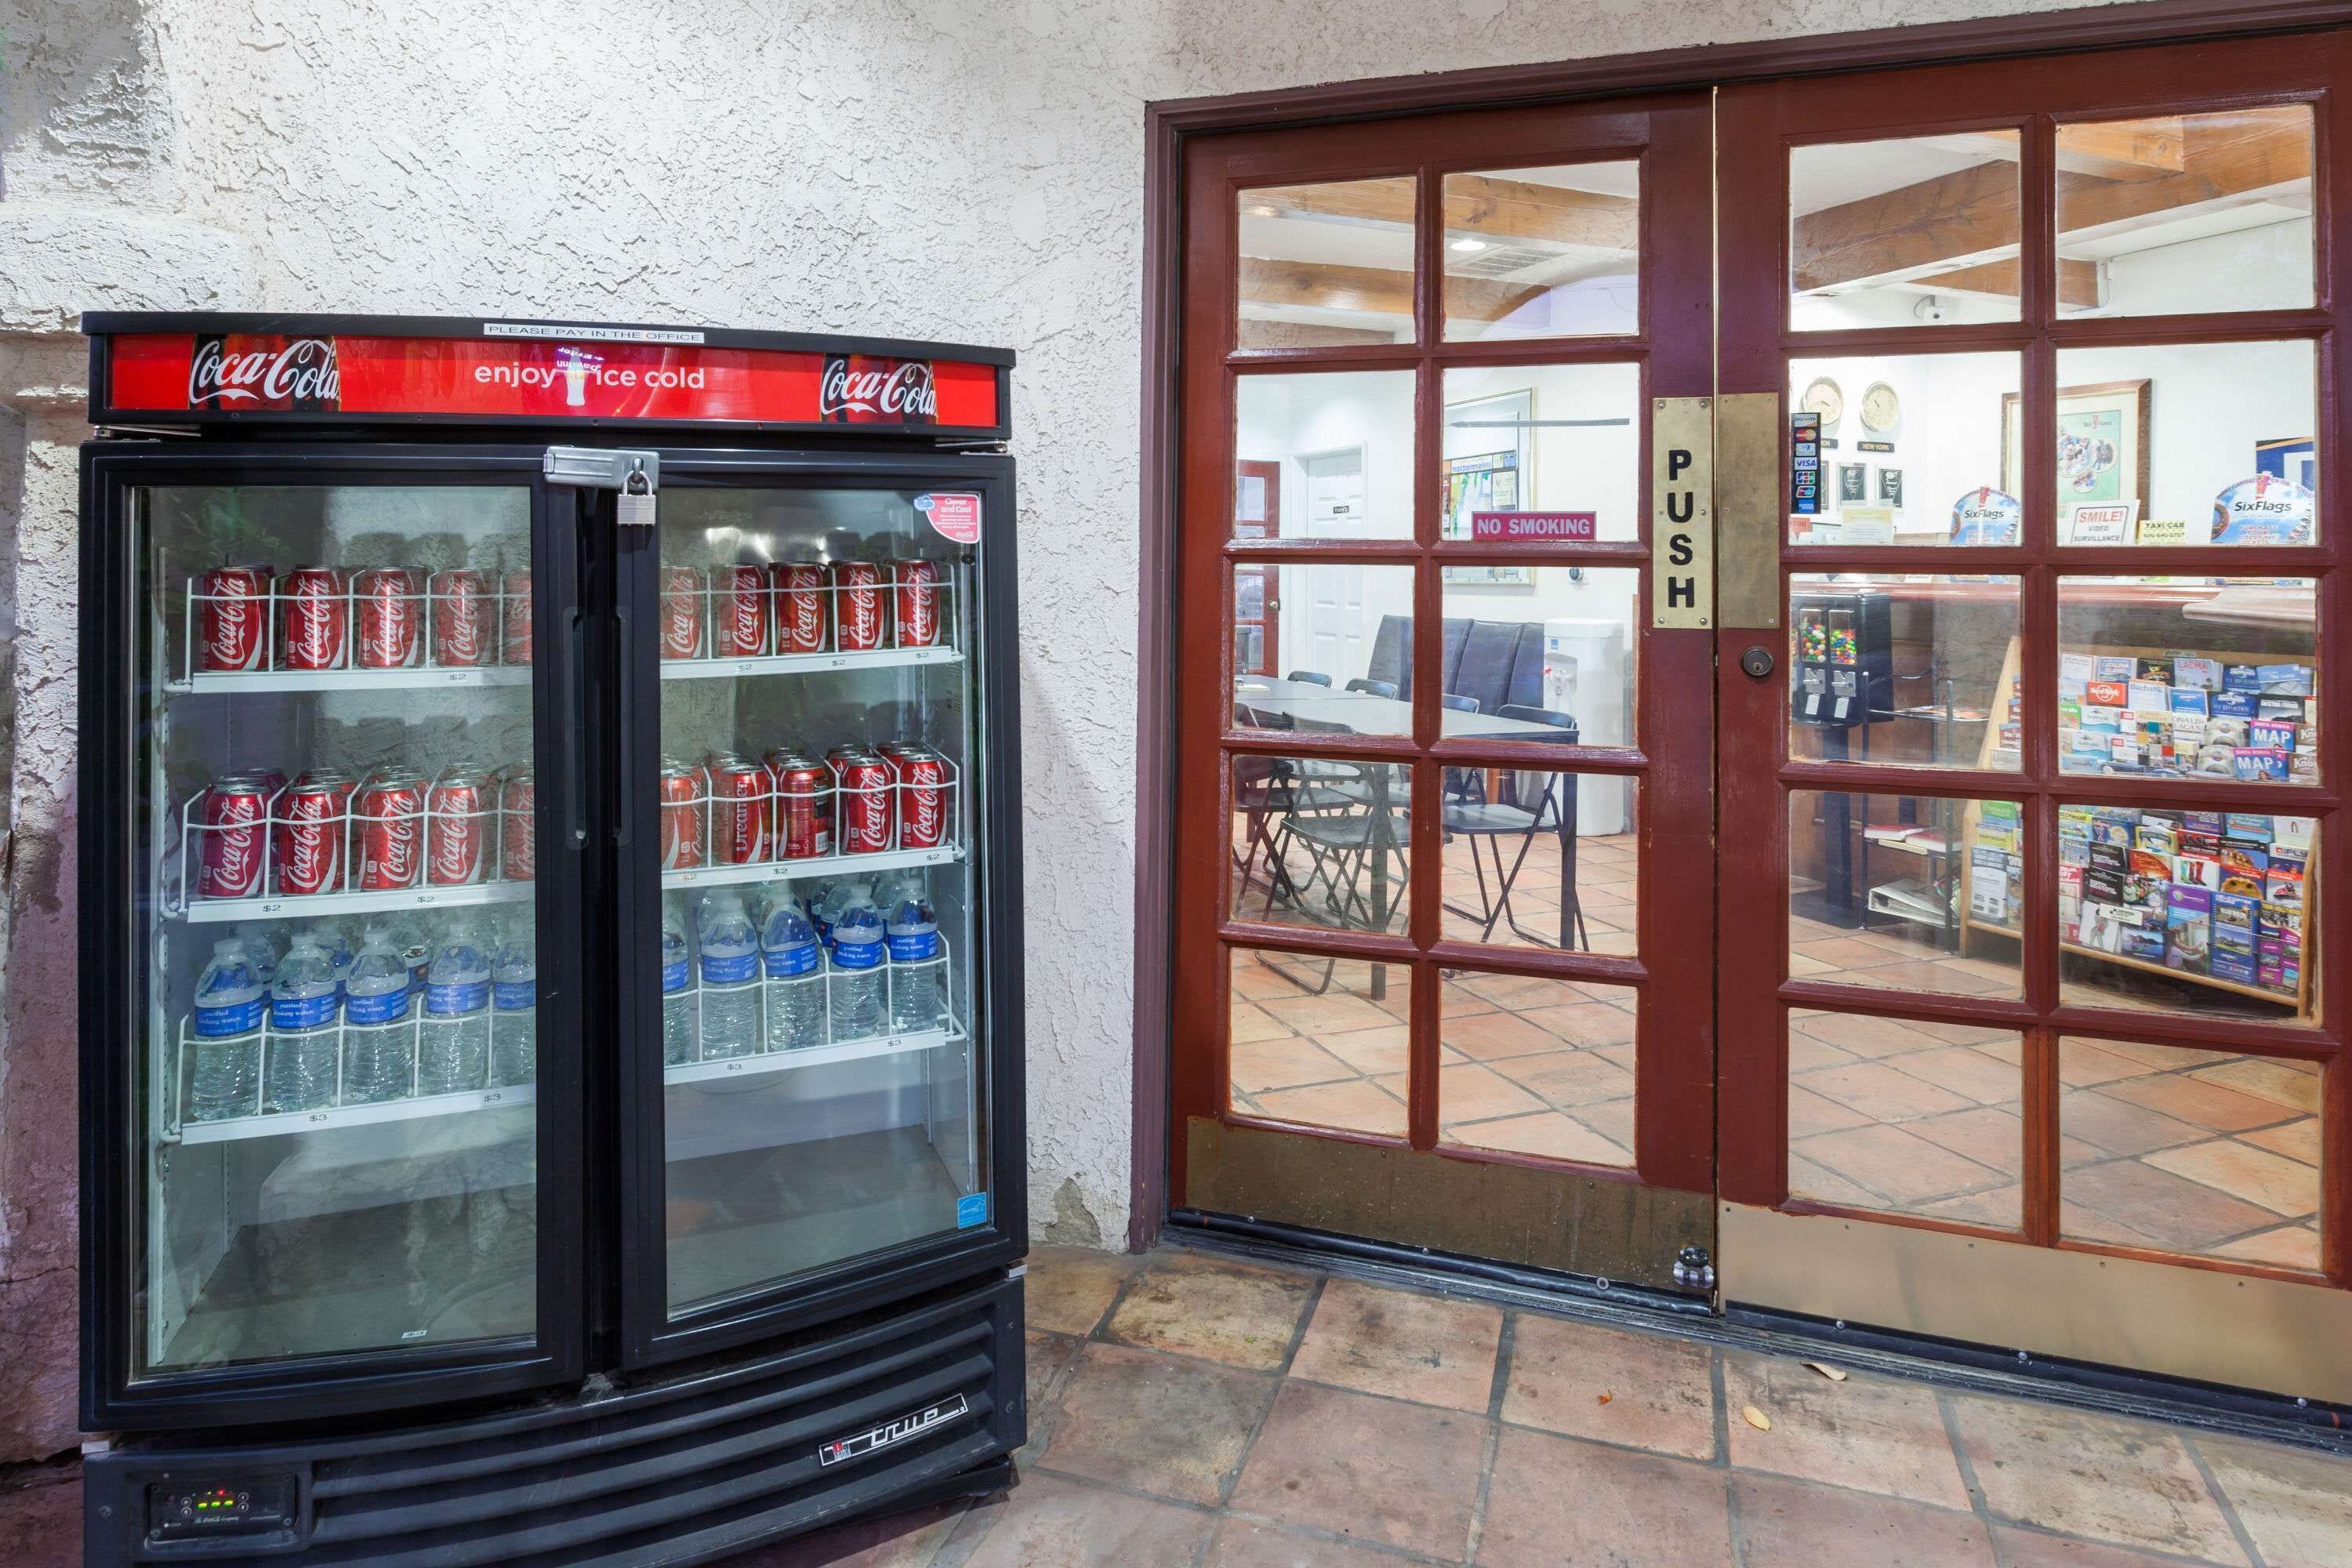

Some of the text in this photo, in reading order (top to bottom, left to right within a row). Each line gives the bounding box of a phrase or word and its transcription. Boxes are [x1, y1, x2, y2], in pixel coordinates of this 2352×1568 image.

[189, 339, 340, 404] Coca-Cola
[489, 325, 550, 335] PLEASE
[555, 328, 586, 337] PAY
[612, 330, 641, 339] THE
[645, 332, 700, 341] OFFICE
[474, 361, 704, 389] enjoy ice cold
[820, 359, 937, 416] Coca-Cola
[1477, 518, 1591, 535] NO SMOKING
[1667, 449, 1695, 608] PUSH
[2079, 510, 2124, 523] SMILE!
[211, 572, 245, 664] Coca-Cola
[297, 573, 331, 664] Coca-Cola
[372, 573, 405, 661] Coca-Cola
[448, 575, 478, 660] Coca-Cola
[666, 575, 695, 653] Coca-Cola
[731, 570, 759, 650] Coca-Cola
[791, 569, 818, 648] Coca-Cola
[849, 567, 875, 644] Coca-Cola
[907, 564, 931, 641] Coca-Cola
[449, 673, 466, 681] $2
[2237, 757, 2274, 770] MAP
[2254, 728, 2291, 744] MAP
[287, 795, 321, 888] Coca-Cola
[379, 793, 414, 882] Coca-Cola
[437, 789, 469, 879] Coca-Cola
[860, 768, 885, 847] Coca-Cola
[913, 764, 938, 842] Coca-Cola
[213, 797, 254, 891] Coca-Cola
[682, 873, 698, 881] $2
[263, 904, 282, 913] $2
[309, 1113, 327, 1123] $3
[484, 1094, 502, 1102] $3
